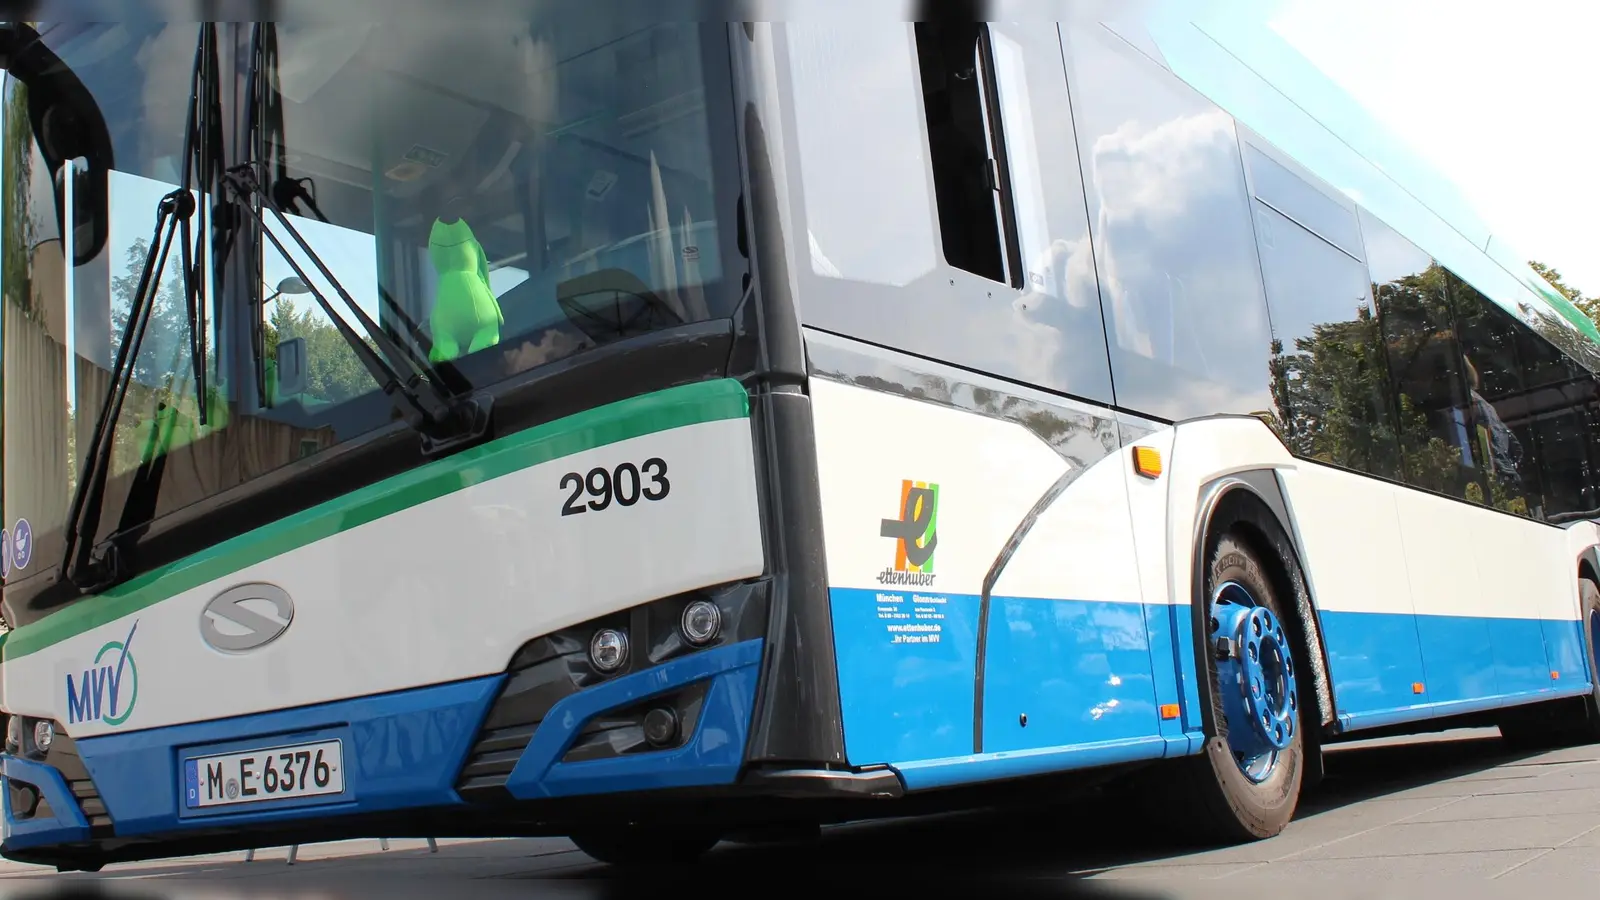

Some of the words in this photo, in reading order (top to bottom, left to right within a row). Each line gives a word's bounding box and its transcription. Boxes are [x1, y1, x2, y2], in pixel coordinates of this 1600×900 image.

[559, 457, 670, 516] 2903
[876, 567, 936, 586] ettenhuber
[887, 623, 941, 632] www.ettenhuber.de
[903, 634, 922, 643] Partner
[67, 618, 139, 724] MVV
[207, 762, 223, 799] M
[189, 788, 196, 799] D
